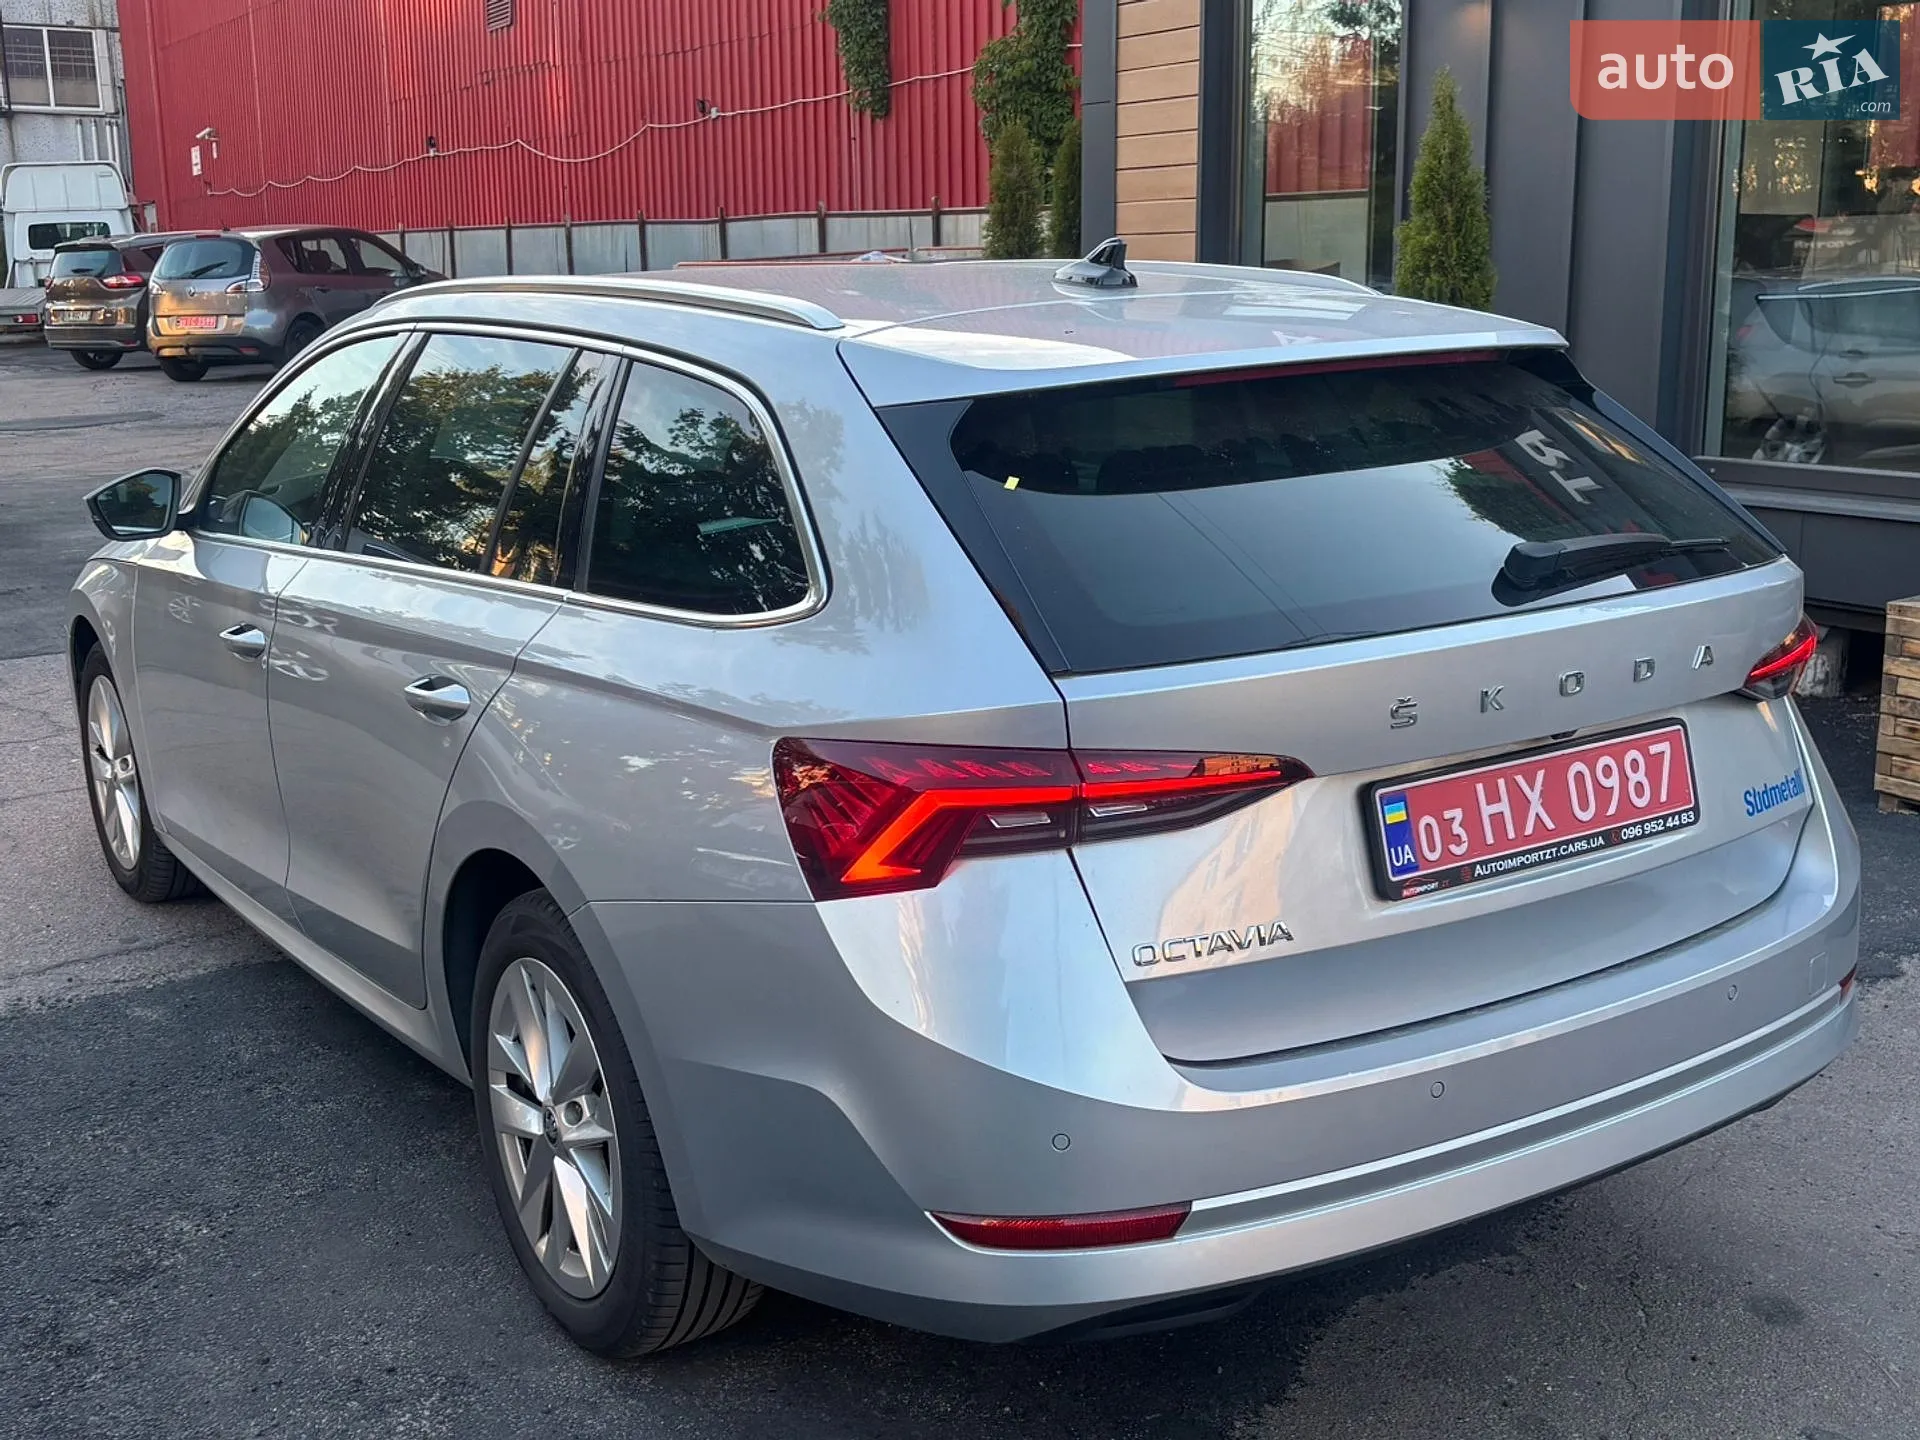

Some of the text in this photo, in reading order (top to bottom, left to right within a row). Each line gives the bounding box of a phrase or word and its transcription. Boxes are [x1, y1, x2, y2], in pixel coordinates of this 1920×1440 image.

[1390, 645, 1715, 730] ŠKODA
[1390, 741, 1671, 867] UA 03 HX 0987
[1621, 825, 1643, 840] 096
[1643, 819, 1665, 835] 952
[1666, 814, 1680, 828] 44
[1681, 810, 1695, 824] 83
[1131, 920, 1294, 967] OCTAVIA
